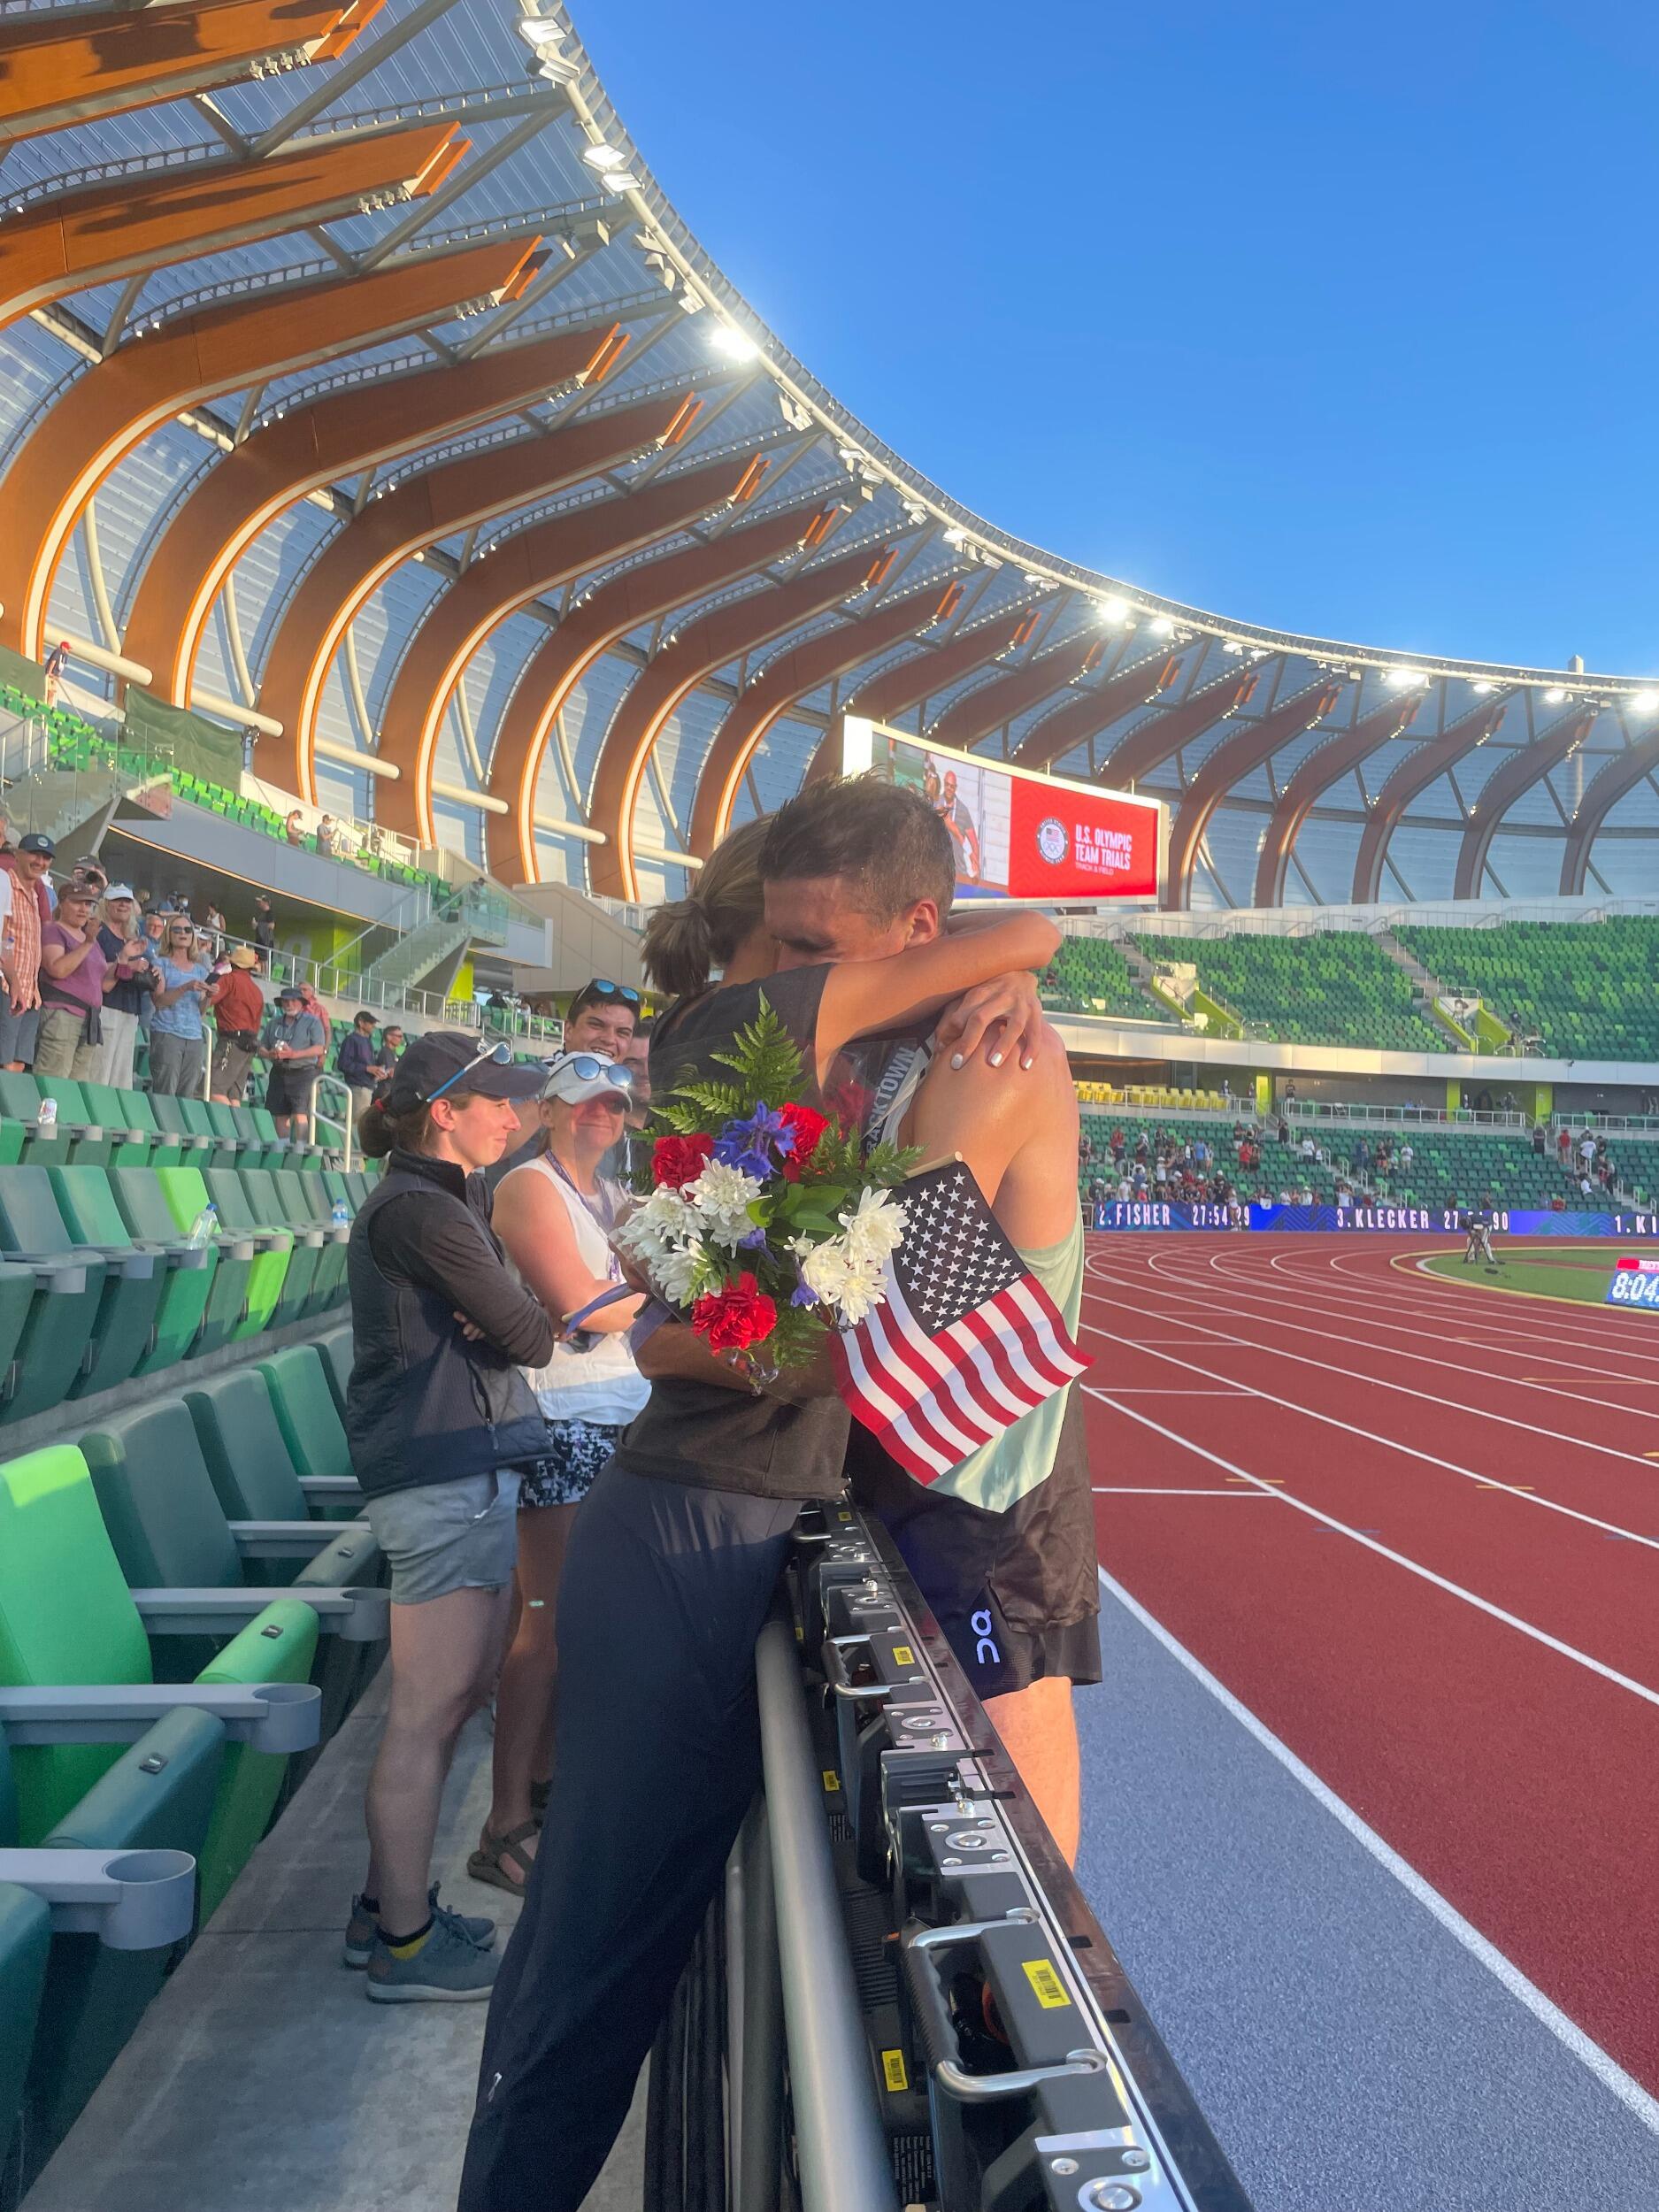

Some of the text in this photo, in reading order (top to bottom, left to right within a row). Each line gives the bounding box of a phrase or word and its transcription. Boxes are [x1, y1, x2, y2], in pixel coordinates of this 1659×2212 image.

[1075, 824, 1092, 844] U.S.
[1094, 828, 1133, 852] OLYMPIC
[1075, 843, 1131, 871] TEAM TRIALS
[866, 1046, 917, 1154] RACKTOWN
